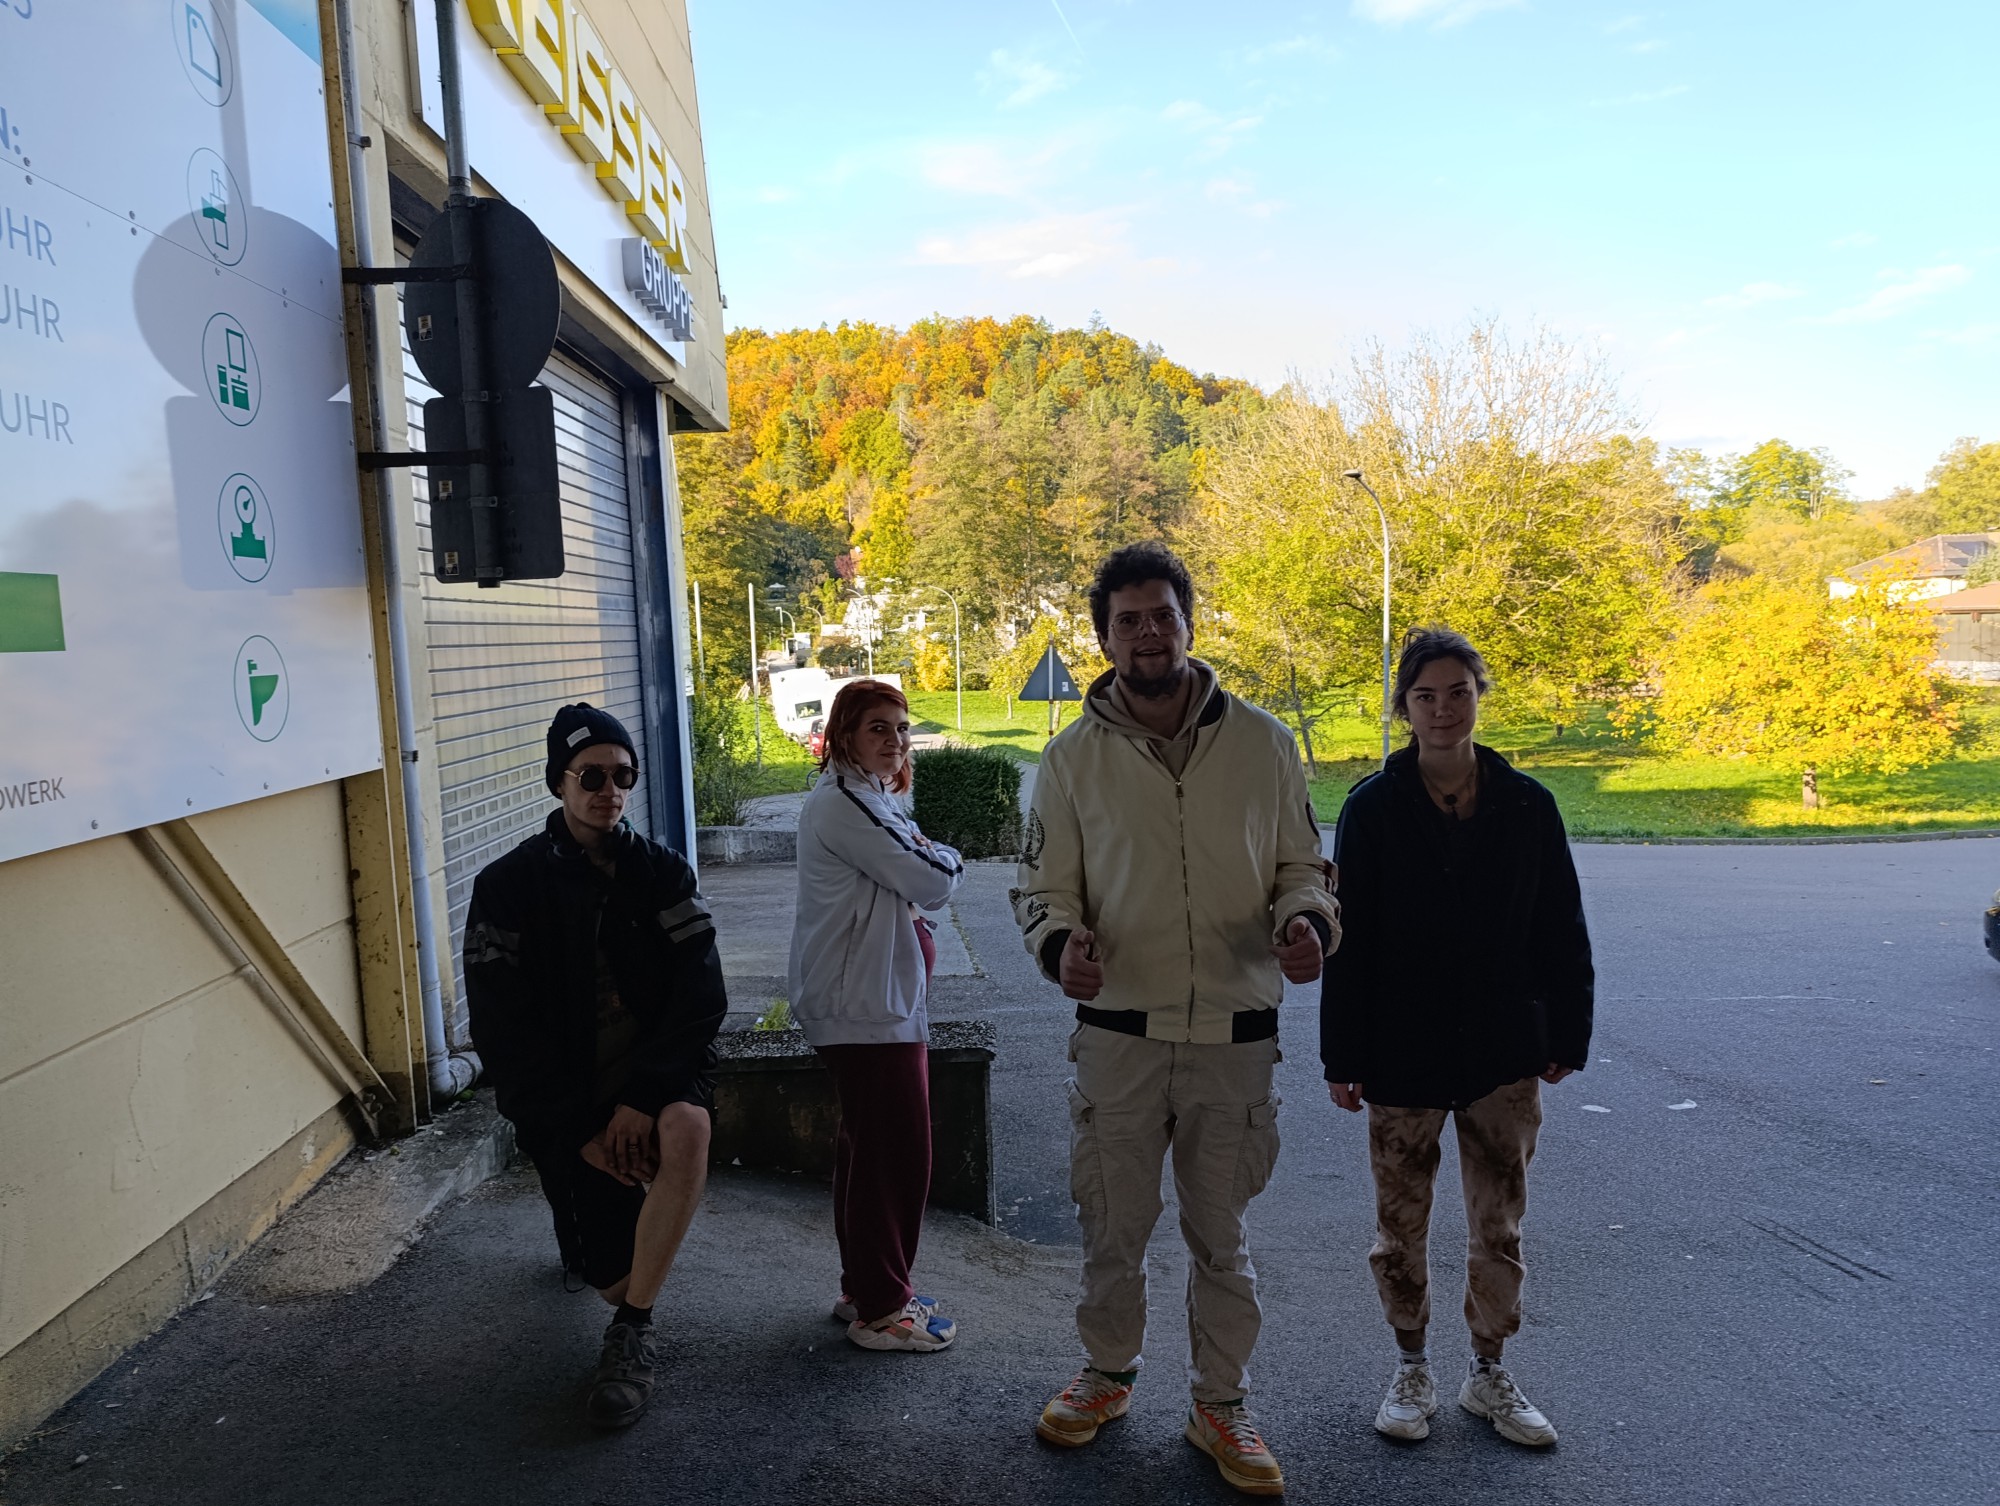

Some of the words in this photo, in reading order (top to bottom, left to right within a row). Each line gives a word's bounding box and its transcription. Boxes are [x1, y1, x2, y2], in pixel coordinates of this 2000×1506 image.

[466, 0, 691, 274] EISSER
[0, 205, 56, 266] HR
[0, 388, 74, 445] UHR
